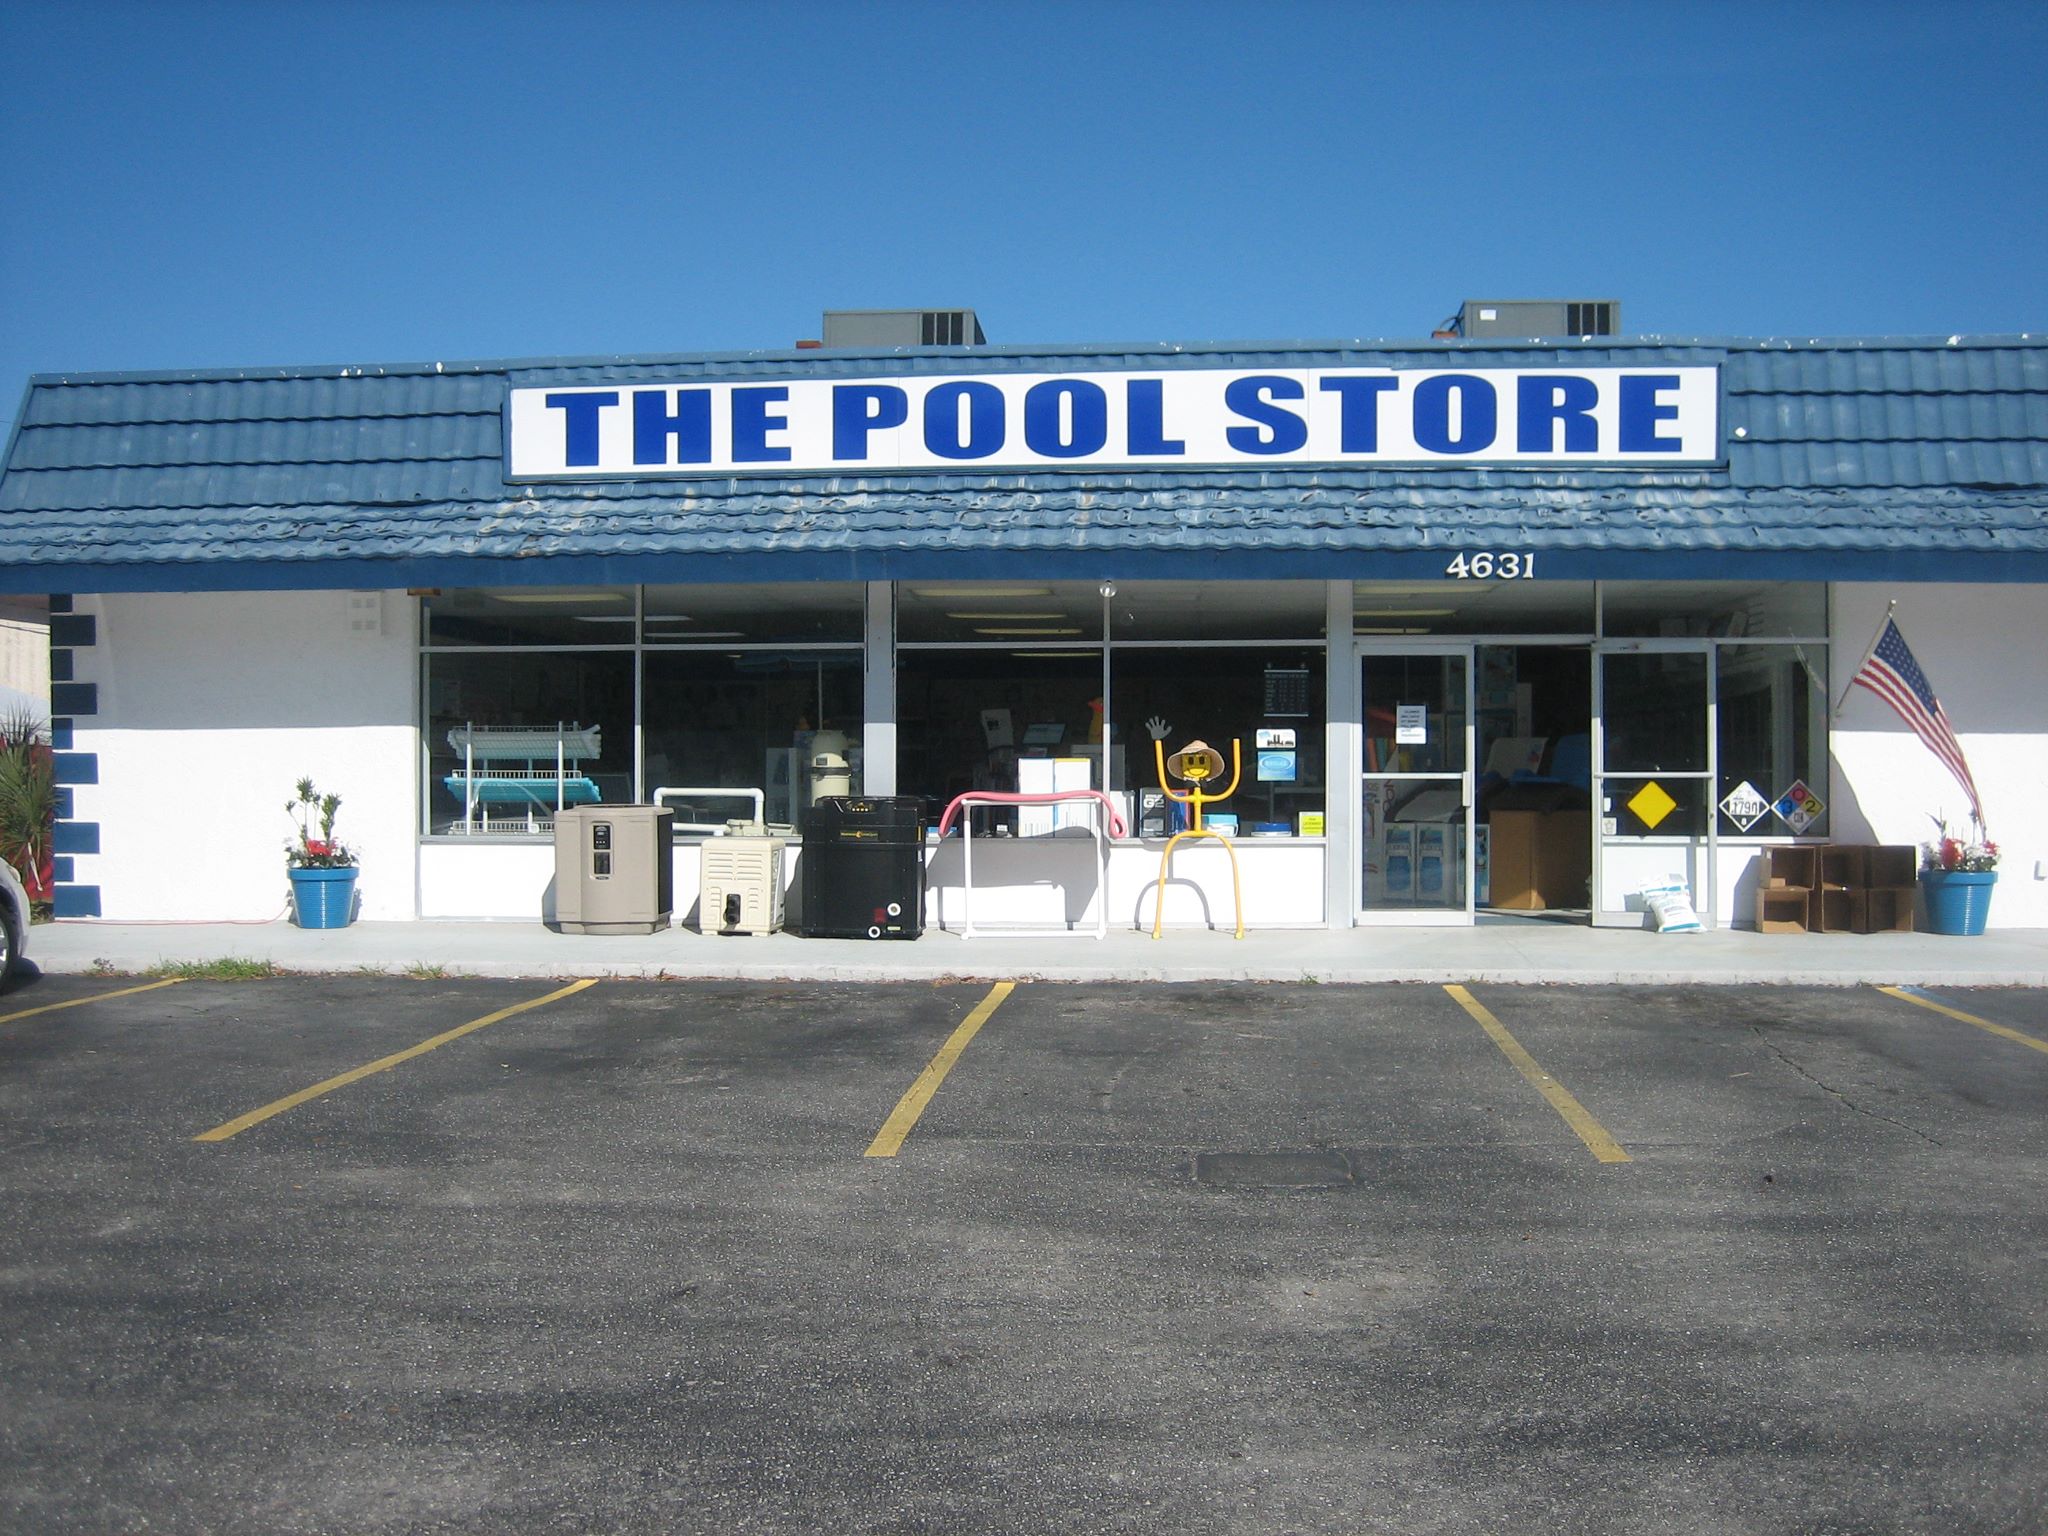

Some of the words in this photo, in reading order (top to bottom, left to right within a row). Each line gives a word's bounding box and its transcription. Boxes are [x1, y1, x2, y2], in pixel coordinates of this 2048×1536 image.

[545, 386, 792, 467] THE
[832, 379, 1185, 461] POOL
[1224, 374, 1683, 455] STORE
[1445, 552, 1534, 579] 4631
[1805, 800, 1816, 813] 2
